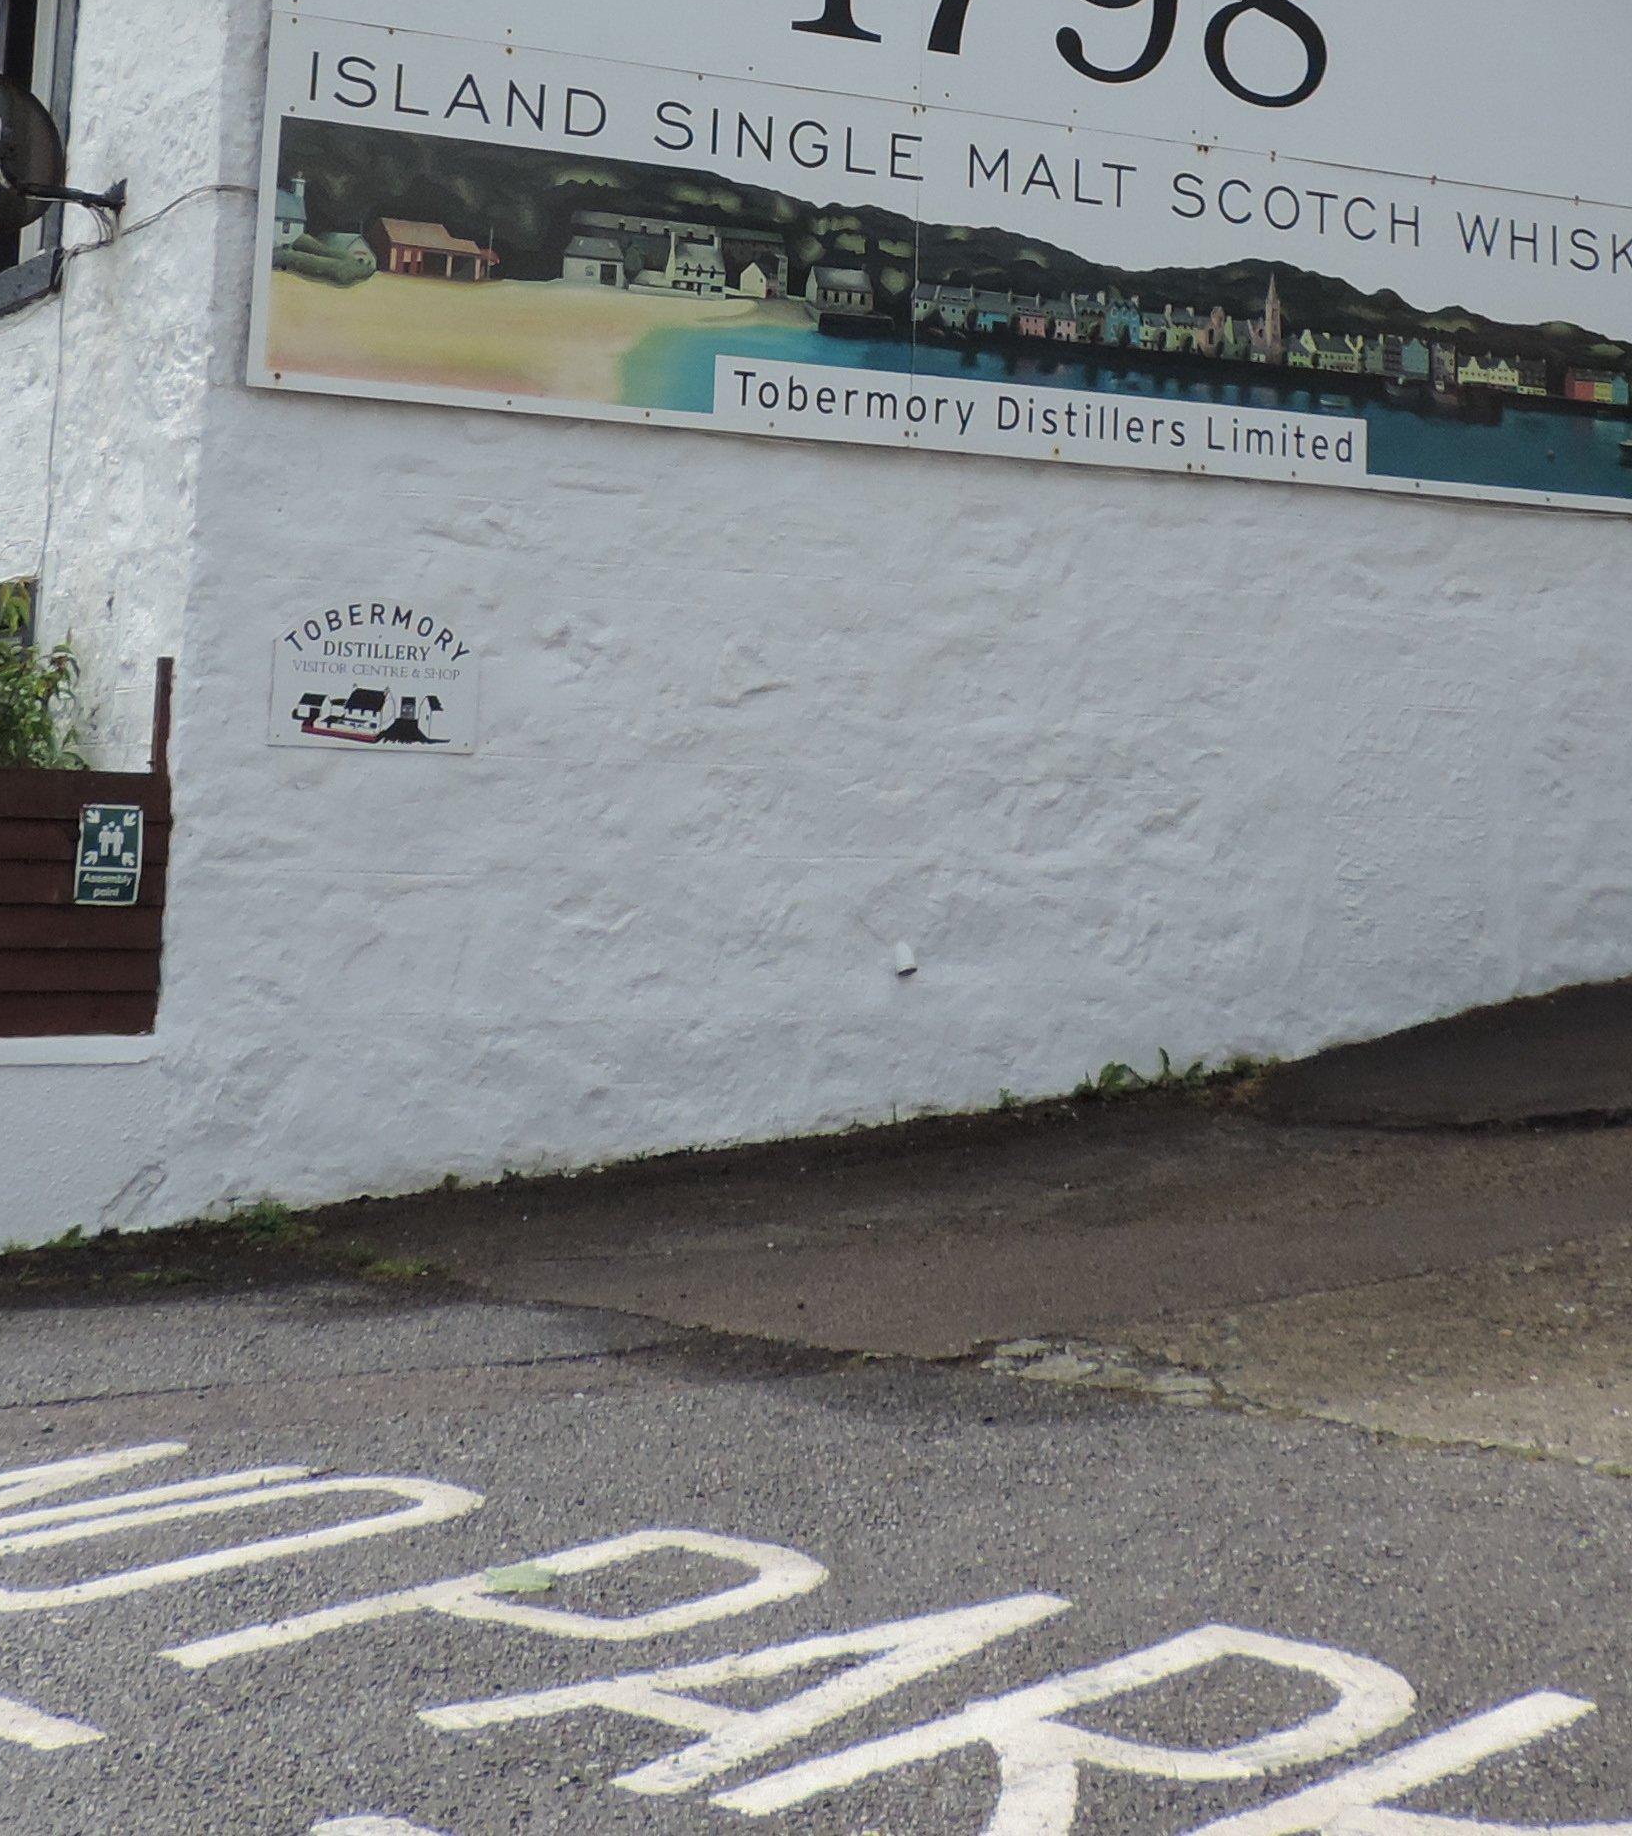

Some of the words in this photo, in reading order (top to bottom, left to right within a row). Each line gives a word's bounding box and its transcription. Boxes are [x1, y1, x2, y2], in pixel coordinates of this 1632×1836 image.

[309, 51, 607, 138] ISLAND
[653, 102, 924, 182] SINGLE
[968, 142, 1137, 208] MALT
[1171, 172, 1420, 247] SCOTCH
[733, 370, 975, 436] Tobermory
[997, 395, 1187, 448] Distillers
[1206, 415, 1354, 464] Limited
[284, 602, 470, 663] TOBERMORY
[323, 640, 431, 662] DISTILLERY
[292, 659, 347, 675] VISITOR
[352, 663, 409, 678] CENTRE
[411, 668, 420, 678] &
[425, 668, 460, 681] SHOP
[82, 872, 134, 888] Assembly
